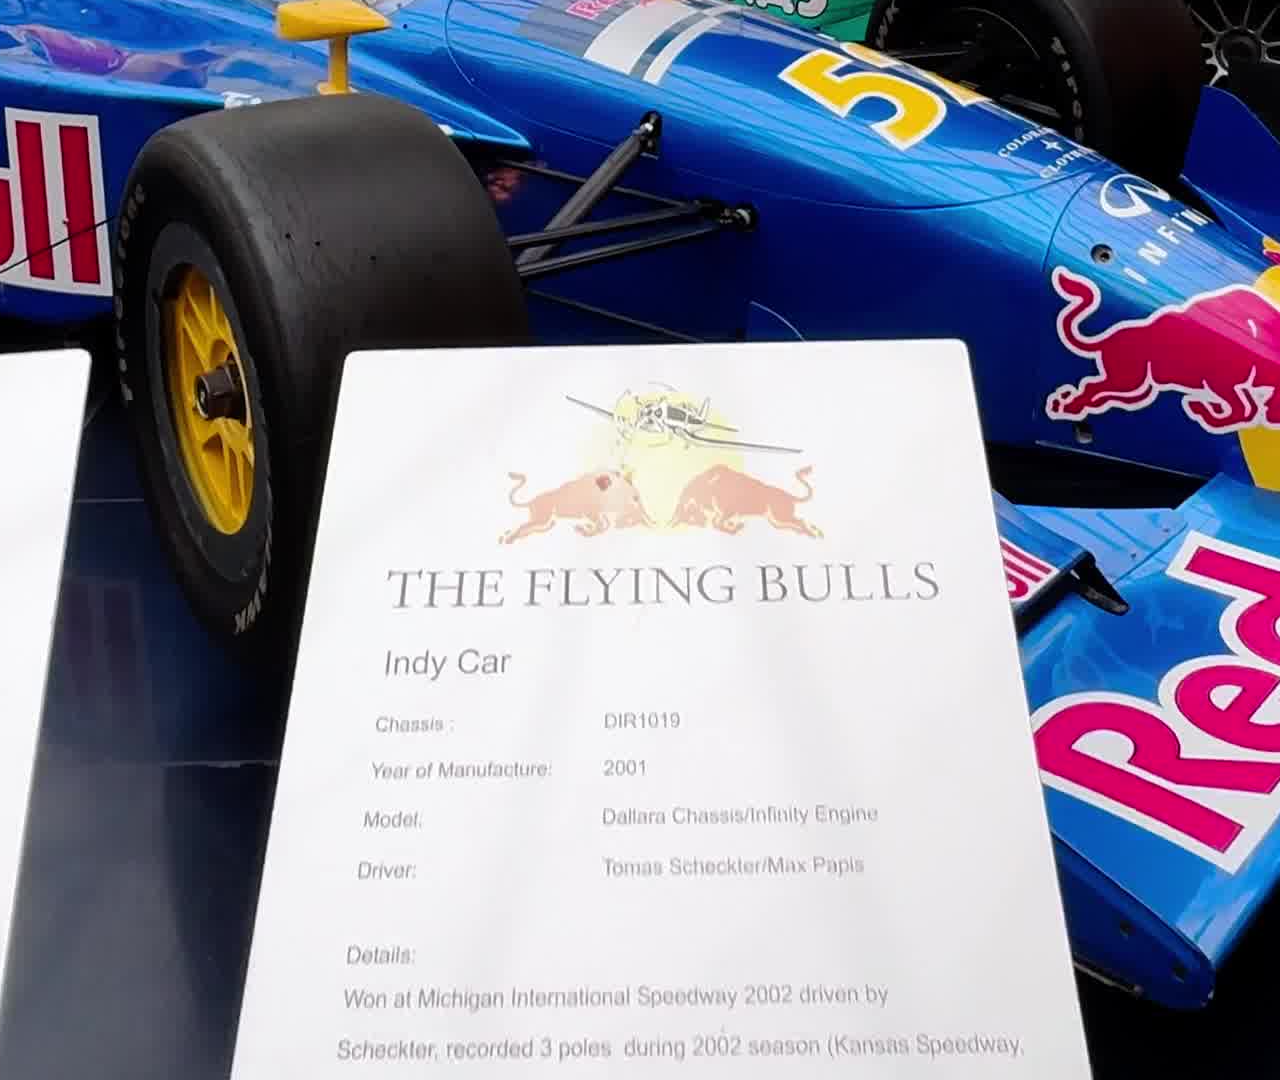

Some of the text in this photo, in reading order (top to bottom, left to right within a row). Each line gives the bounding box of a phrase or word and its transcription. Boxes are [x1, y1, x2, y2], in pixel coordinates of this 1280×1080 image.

[386, 561, 942, 610] THE FLYING BULLS
[383, 648, 512, 681] Indy Car
[375, 711, 681, 734] Chassis DIR1019
[370, 759, 648, 780] Year of Manufacture: 2001
[602, 808, 666, 826] Dallara
[672, 806, 809, 827] Chassis/Infinity
[815, 805, 879, 825] Engine
[357, 861, 417, 880] Driver:
[603, 857, 664, 877] Tomas
[813, 856, 865, 877] Papis
[346, 945, 416, 966] Details:
[343, 985, 889, 1013] Won at Michigan International Speedway 2002 driven by
[336, 1038, 439, 1062] Scheckter,
[446, 1036, 533, 1059] recorded
[540, 1037, 553, 1058] 3
[559, 1037, 612, 1061] poles
[623, 1034, 686, 1062] during
[692, 1033, 741, 1058] 2002
[748, 1038, 820, 1058] season
[827, 1032, 909, 1060] (Kansas
